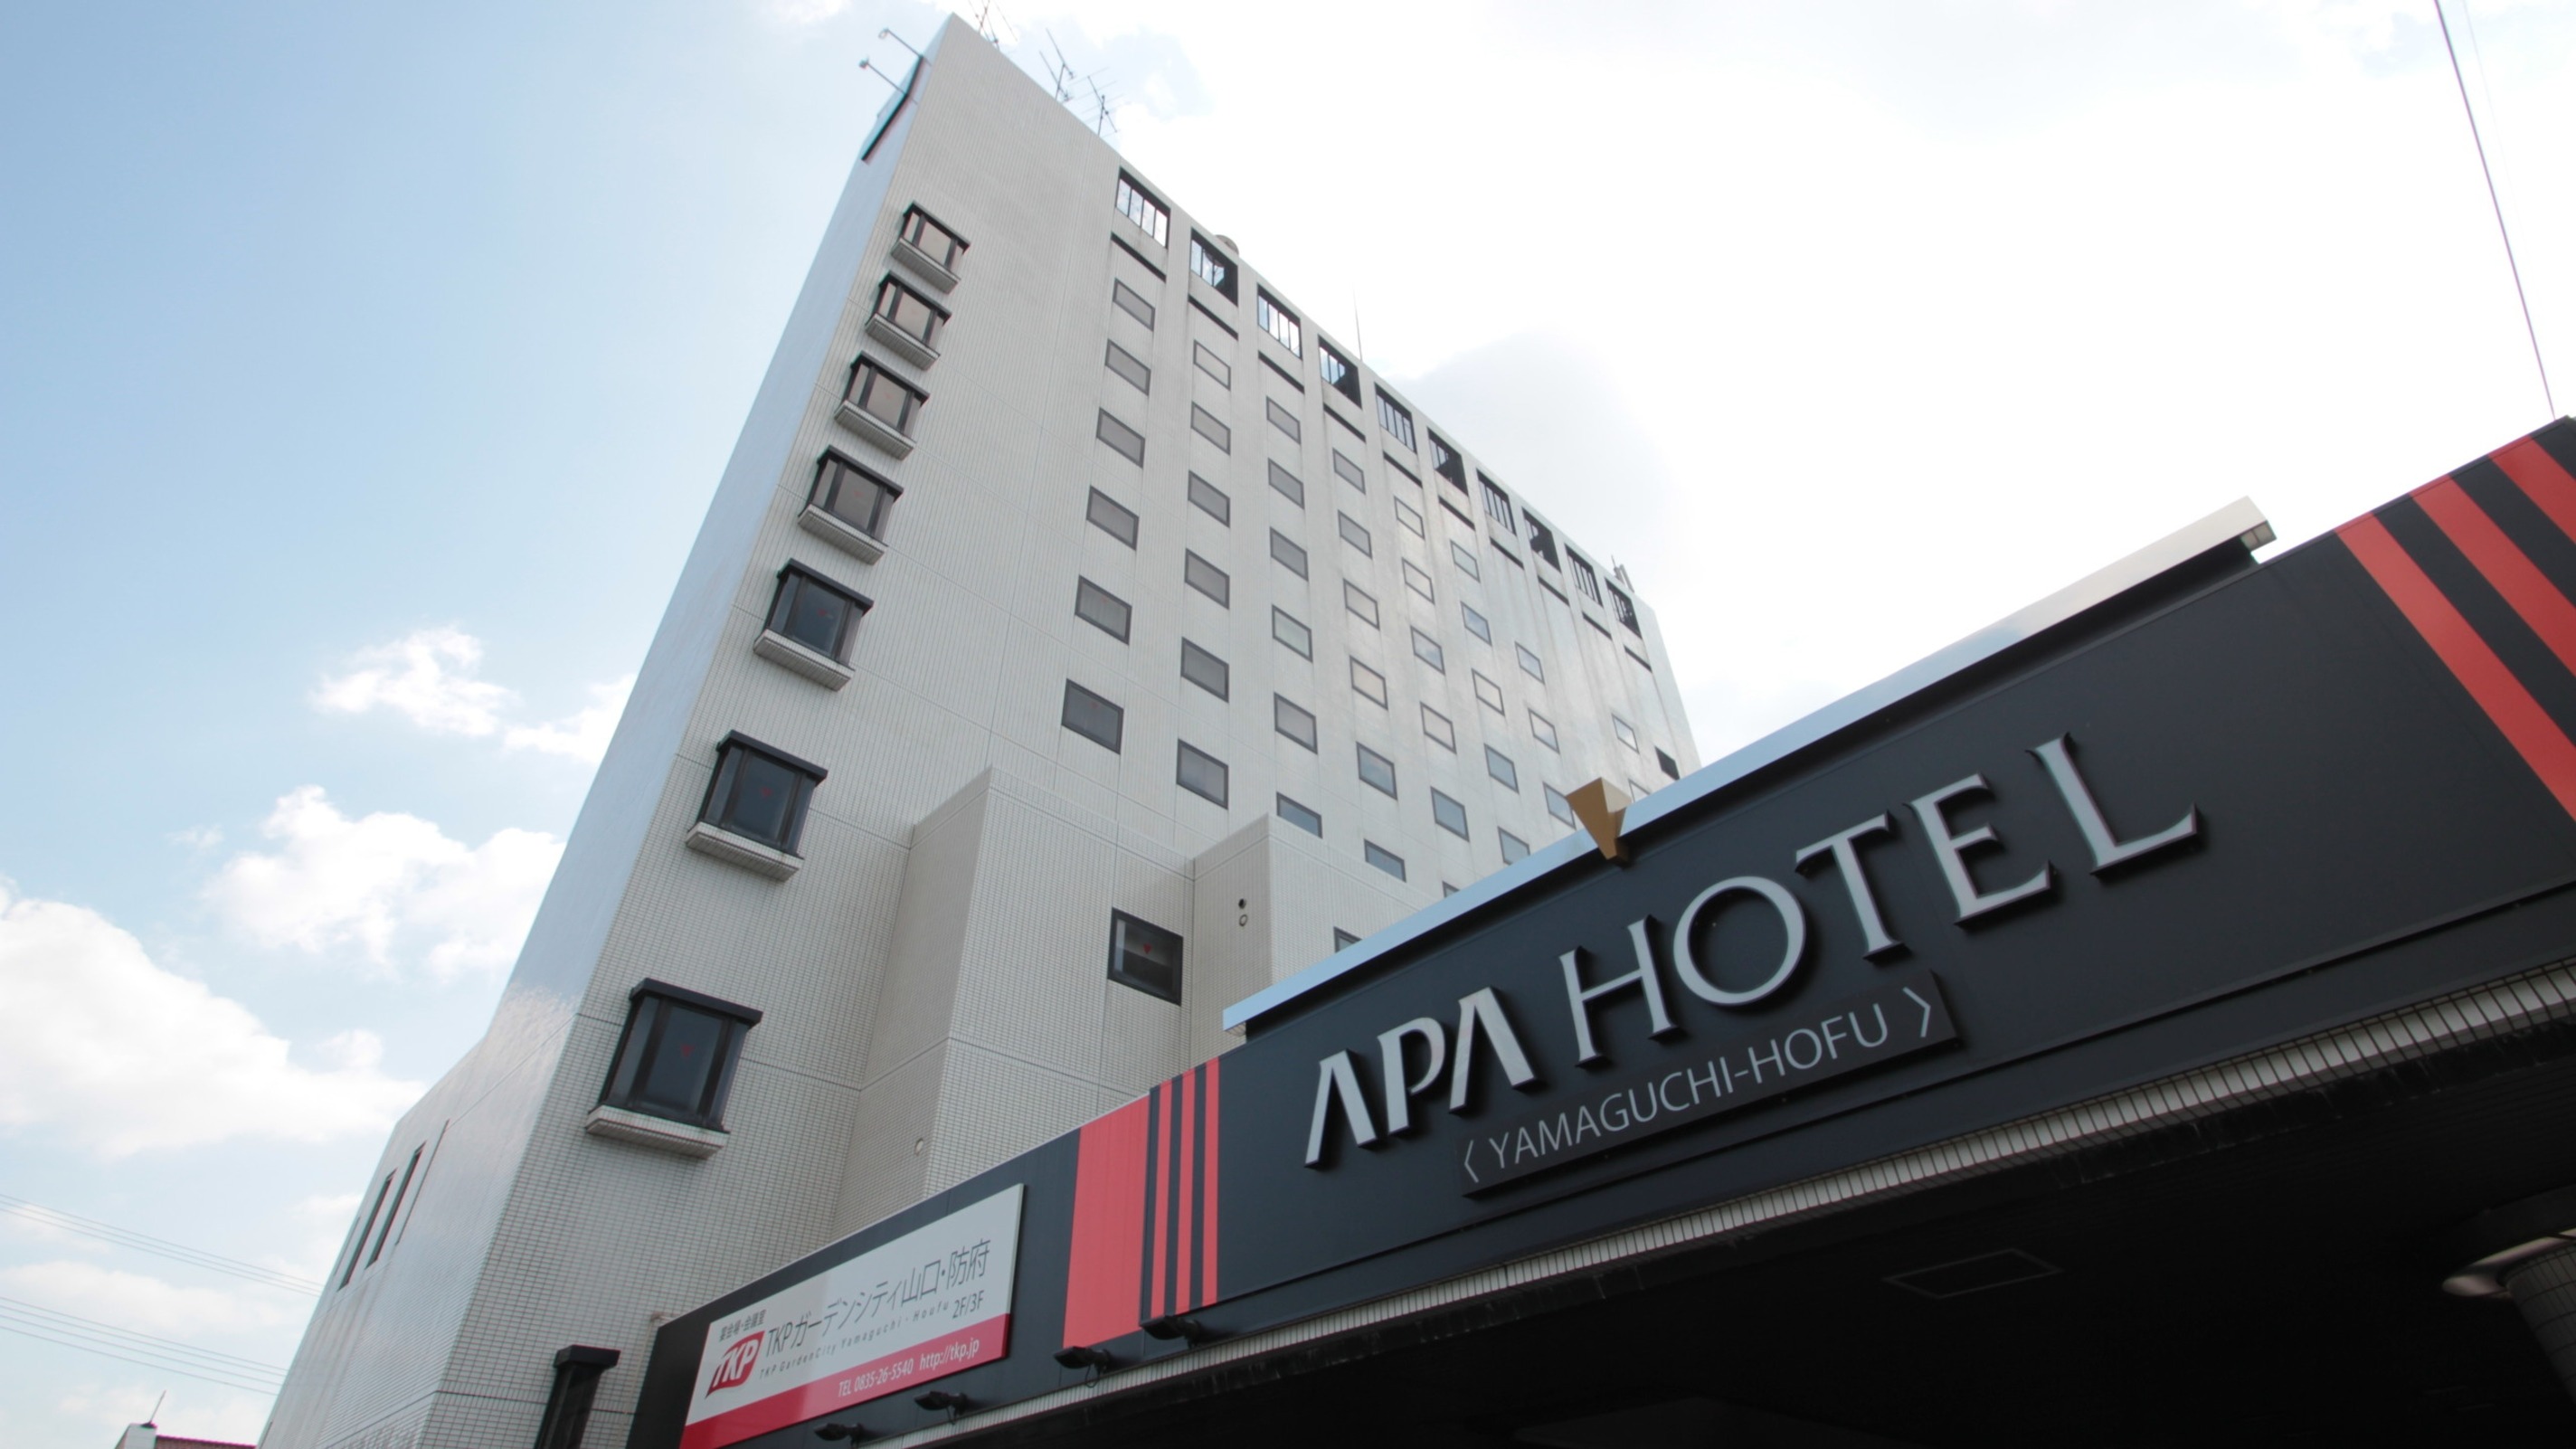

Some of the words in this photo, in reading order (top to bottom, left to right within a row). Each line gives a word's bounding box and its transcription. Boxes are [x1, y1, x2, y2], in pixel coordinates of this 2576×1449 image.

[1304, 986, 1536, 1167] APA
[1559, 732, 2199, 1067] HOTEL
[952, 1290, 984, 1319] 2F/3F
[712, 1338, 761, 1389] TKP
[759, 1363, 777, 1380] TKP
[838, 1378, 852, 1397] TEL
[853, 1358, 914, 1392] 0835-26-5540
[918, 1336, 980, 1371] http://tkp.jp
